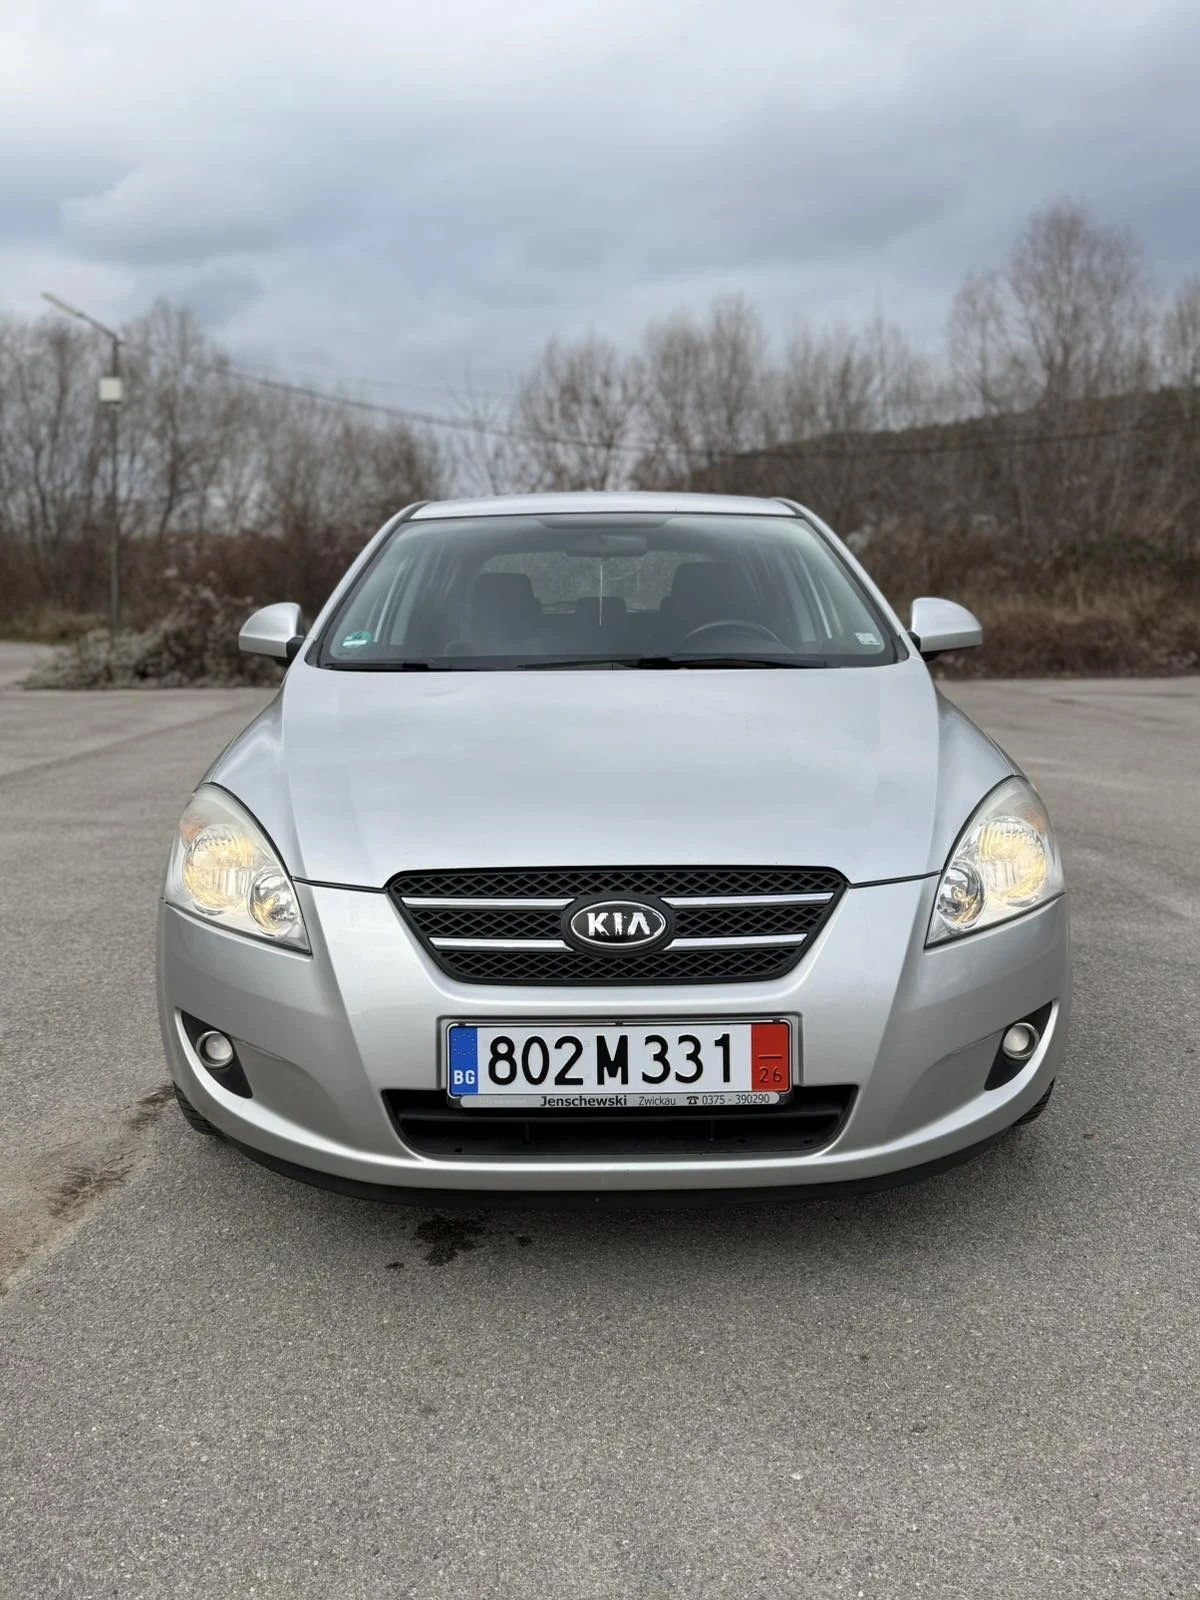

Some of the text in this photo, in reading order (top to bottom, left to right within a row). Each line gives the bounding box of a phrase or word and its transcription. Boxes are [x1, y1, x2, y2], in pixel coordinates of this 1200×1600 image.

[586, 912, 651, 936] KIA
[488, 1033, 732, 1086] 802 M 331
[453, 1069, 476, 1085] BG
[759, 1065, 783, 1083] 26
[540, 1095, 628, 1107] Jenschewski
[638, 1096, 676, 1106] Zwickau
[702, 1095, 726, 1105] 0375
[735, 1094, 770, 1104] 390290
